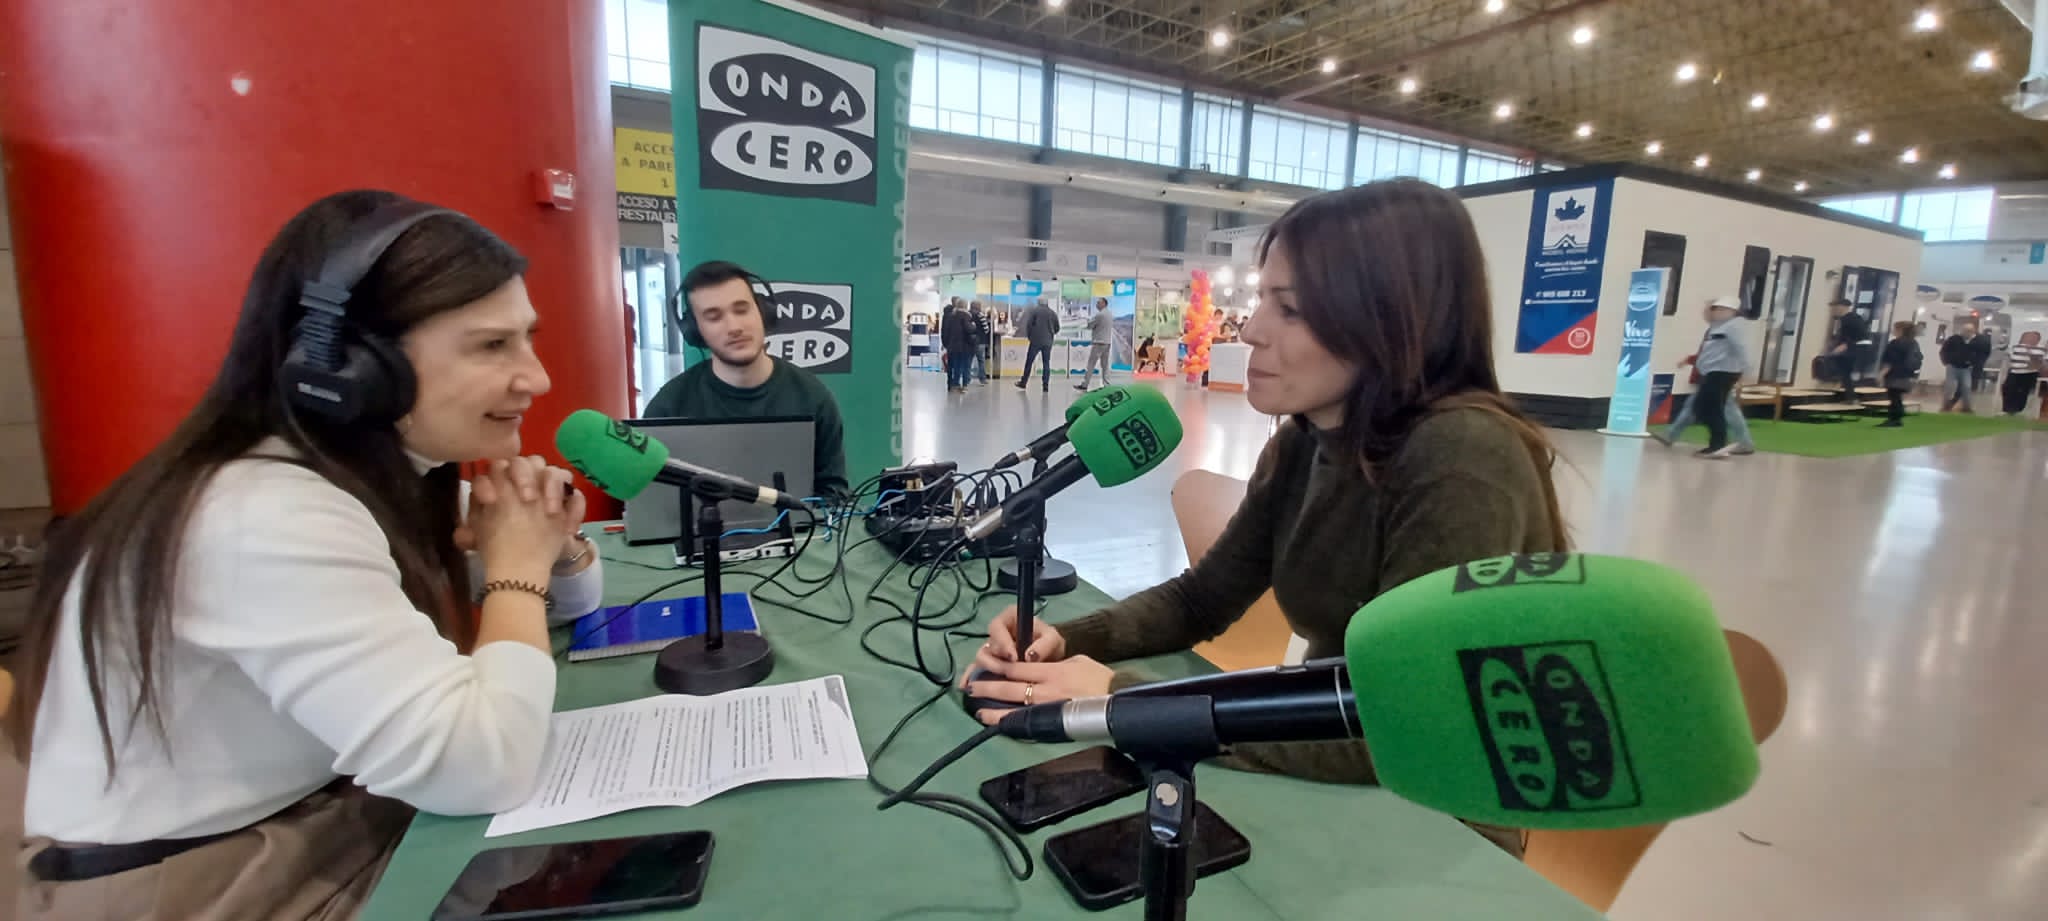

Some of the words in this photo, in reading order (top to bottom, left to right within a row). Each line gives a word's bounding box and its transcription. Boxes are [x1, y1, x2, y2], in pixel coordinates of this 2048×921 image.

[726, 63, 853, 117] ONDA
[622, 157, 631, 167] A
[736, 130, 853, 175] CERO
[619, 196, 659, 209] ACCESO
[662, 199, 670, 209] A
[776, 303, 837, 320] NDA
[766, 338, 837, 361] ERO
[1491, 679, 1547, 791] CERO
[1546, 668, 1600, 789] ONDA
